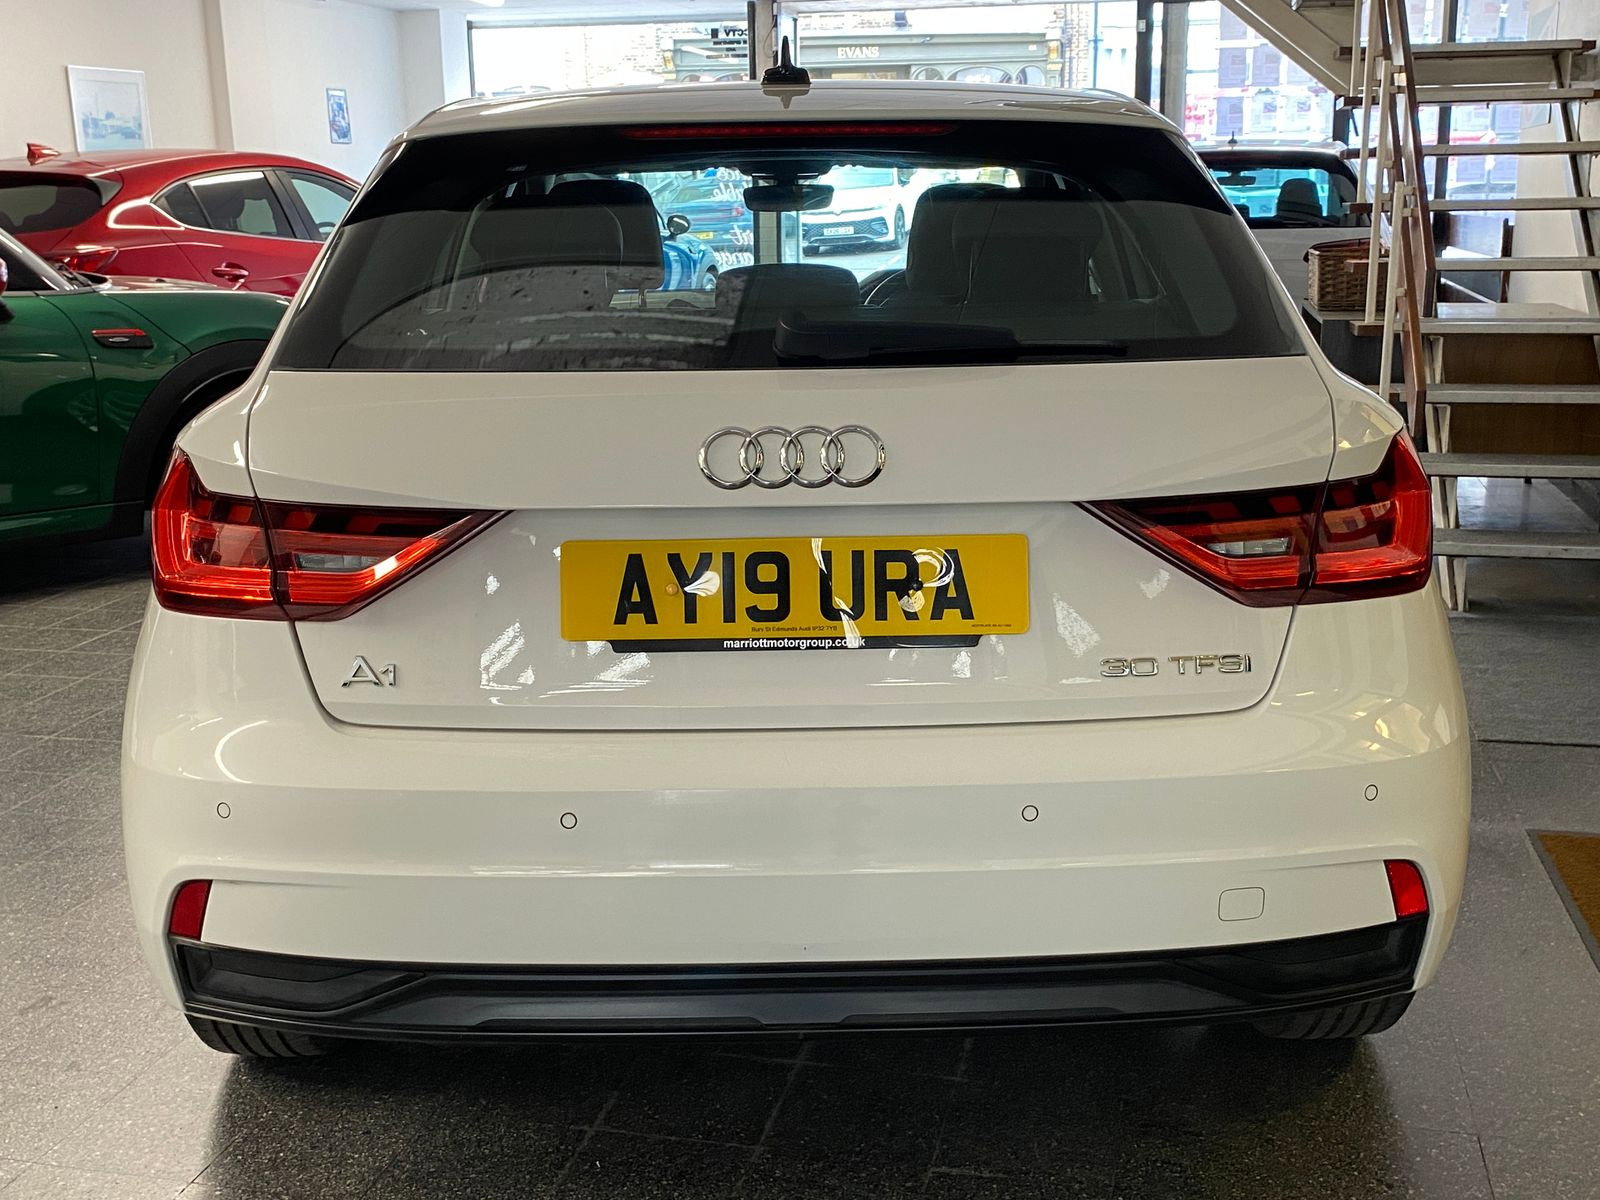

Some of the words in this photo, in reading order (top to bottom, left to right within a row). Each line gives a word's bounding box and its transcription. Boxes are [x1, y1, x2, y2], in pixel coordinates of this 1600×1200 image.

[837, 46, 880, 59] EVANS
[613, 551, 791, 625] AY19
[819, 549, 975, 622] URA
[723, 637, 866, 650] marriottmotorgroup.couk
[341, 655, 397, 687] A1
[1100, 657, 1159, 677] 30
[1168, 654, 1252, 675] TFSI
